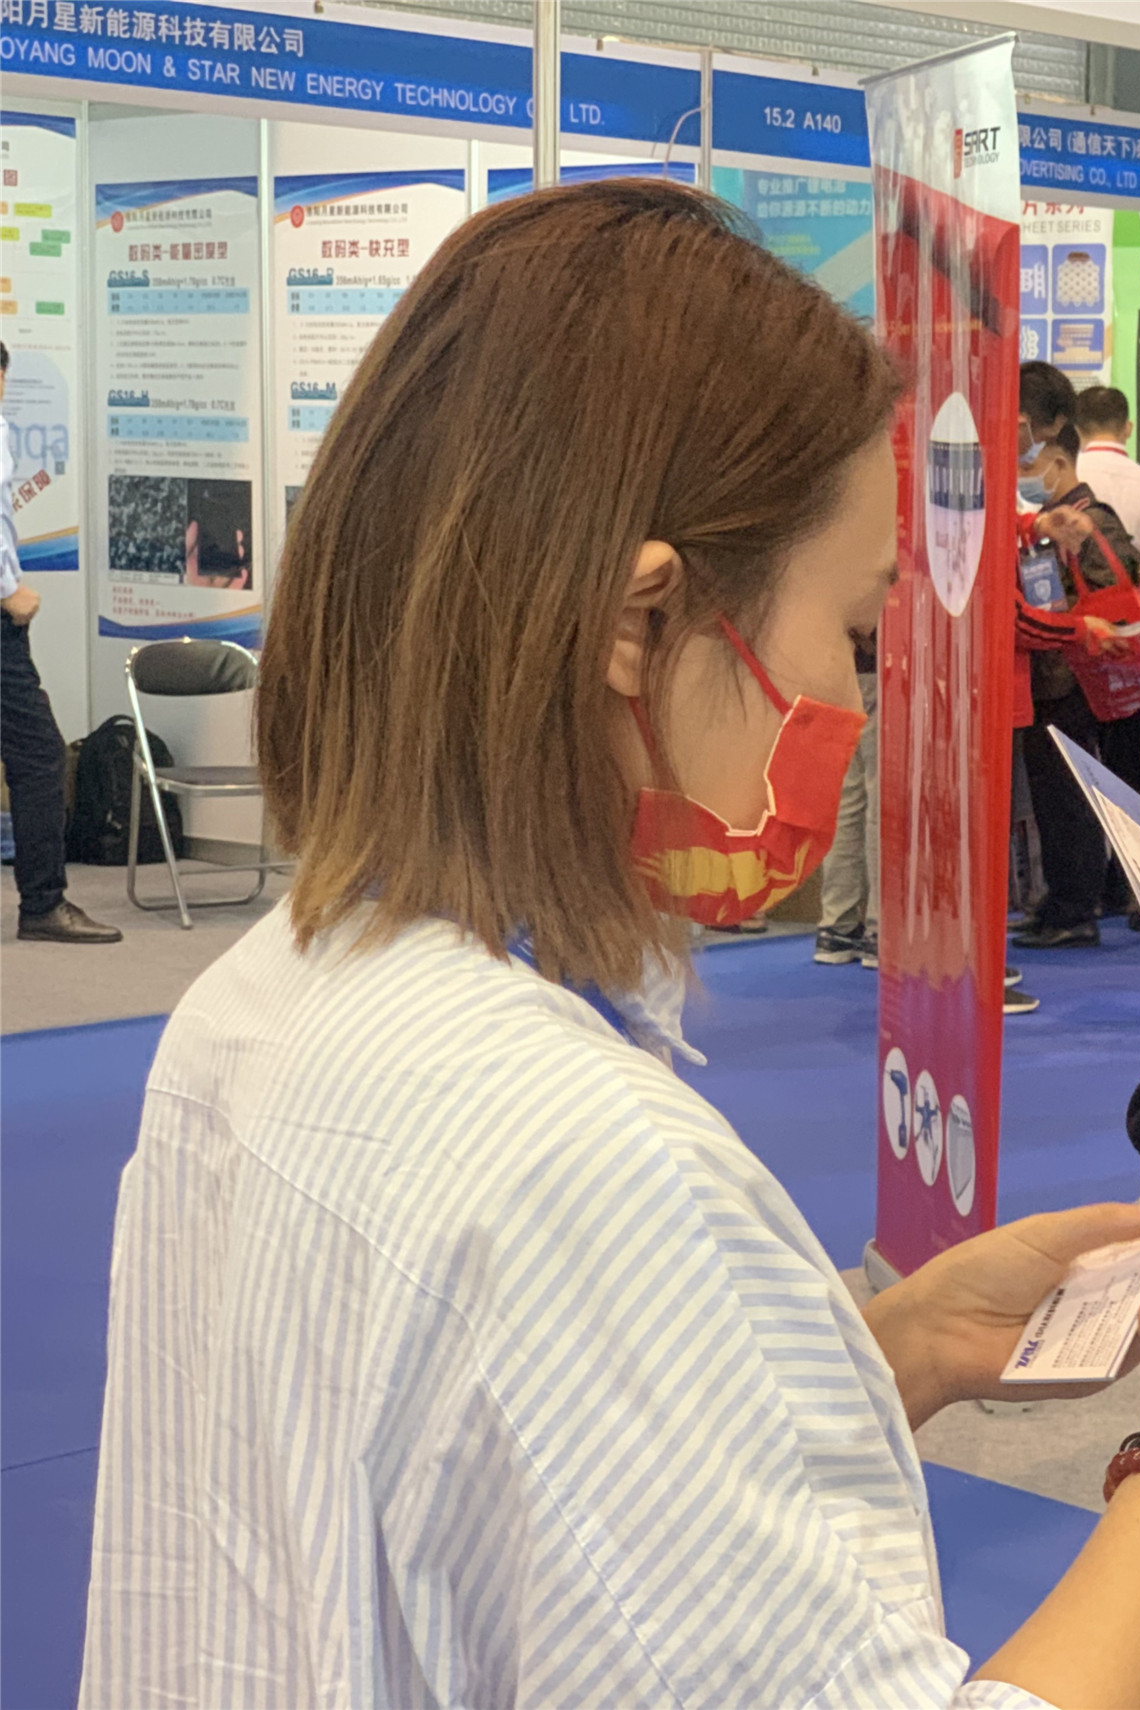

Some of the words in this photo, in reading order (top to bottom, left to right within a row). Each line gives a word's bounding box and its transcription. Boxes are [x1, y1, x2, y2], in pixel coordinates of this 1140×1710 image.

[0, 0, 304, 57] 阳月星新能源科技有限公司
[0, 36, 76, 66] OYANG
[88, 47, 151, 74] MOON
[163, 55, 176, 78] &
[188, 59, 240, 85] STAR
[251, 66, 296, 93] NEW
[307, 73, 384, 101] ENERGY
[394, 82, 517, 115] TECHNOLOGY
[570, 103, 605, 125] LTD.
[764, 106, 795, 128] 15.2
[803, 111, 842, 134] A140
[964, 126, 1001, 156] SART
[1117, 170, 1138, 189] LTD
[1057, 219, 1101, 234] SERIES
